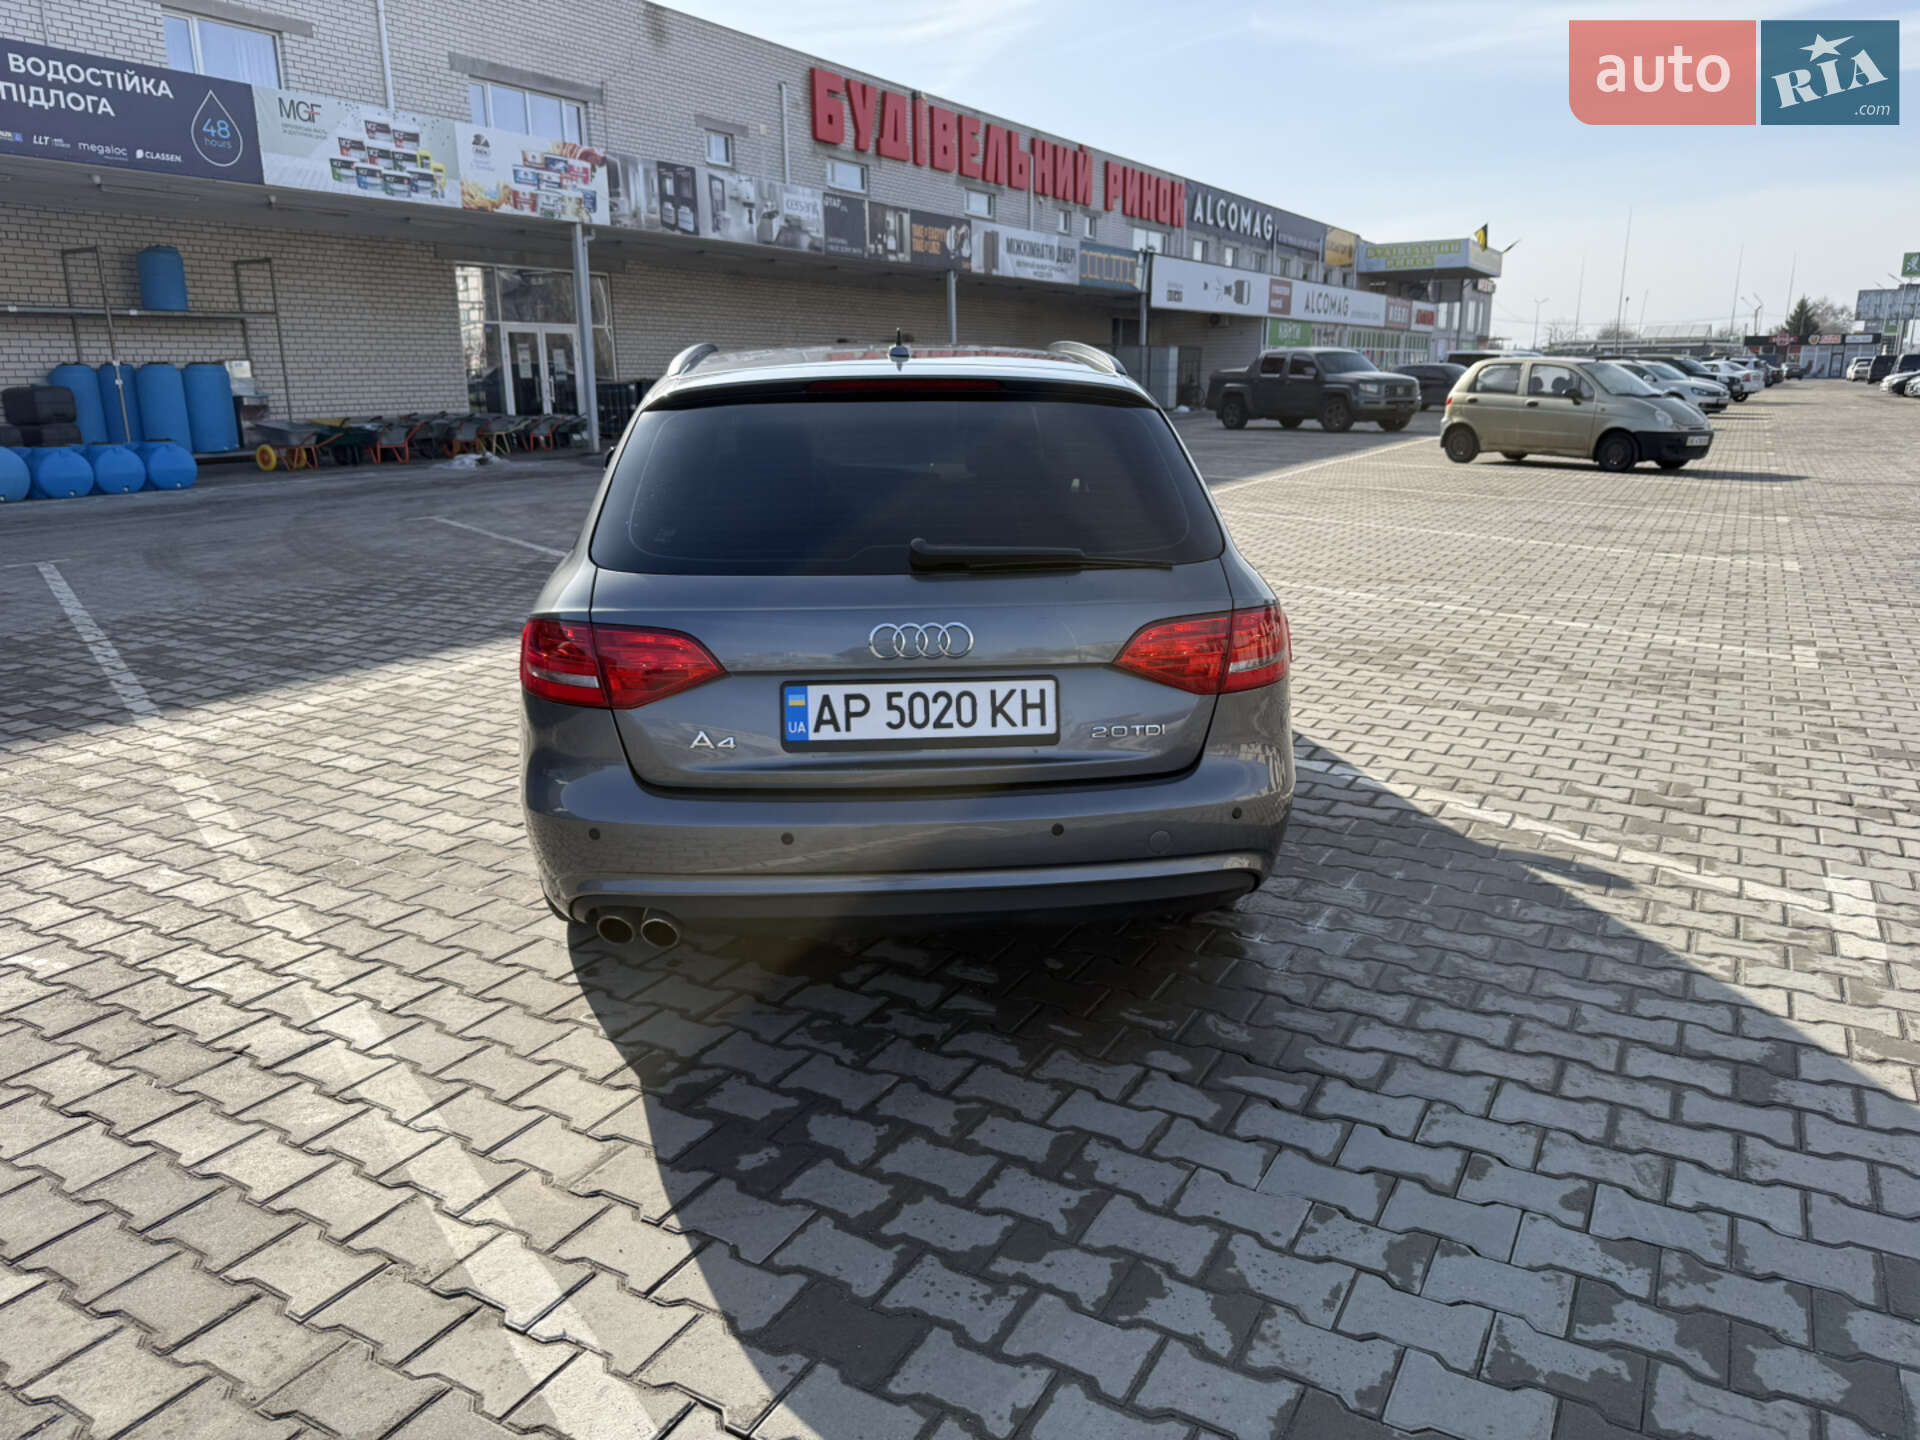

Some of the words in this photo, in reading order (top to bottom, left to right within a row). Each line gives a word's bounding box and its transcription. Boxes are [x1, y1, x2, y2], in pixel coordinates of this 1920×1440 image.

[8, 52, 174, 99] ВОДОСТІЙКА
[0, 81, 116, 117] ПІДЛОГА
[278, 97, 322, 123] MGF
[33, 135, 50, 145] LLT
[202, 118, 231, 139] 48
[78, 142, 129, 156] megaloc
[204, 137, 233, 149] hours
[810, 67, 1093, 206] БУДІВЕЛЬНИЙ
[1104, 160, 1185, 228] РИНОК
[145, 151, 182, 163] CLASSEN
[1193, 192, 1273, 240] ALCOMAG
[1304, 290, 1350, 317] ALCOMAG
[813, 693, 871, 734] AP
[886, 690, 978, 730] 5020
[991, 688, 1047, 728] KH
[788, 720, 806, 734] UA
[689, 730, 737, 750] A4
